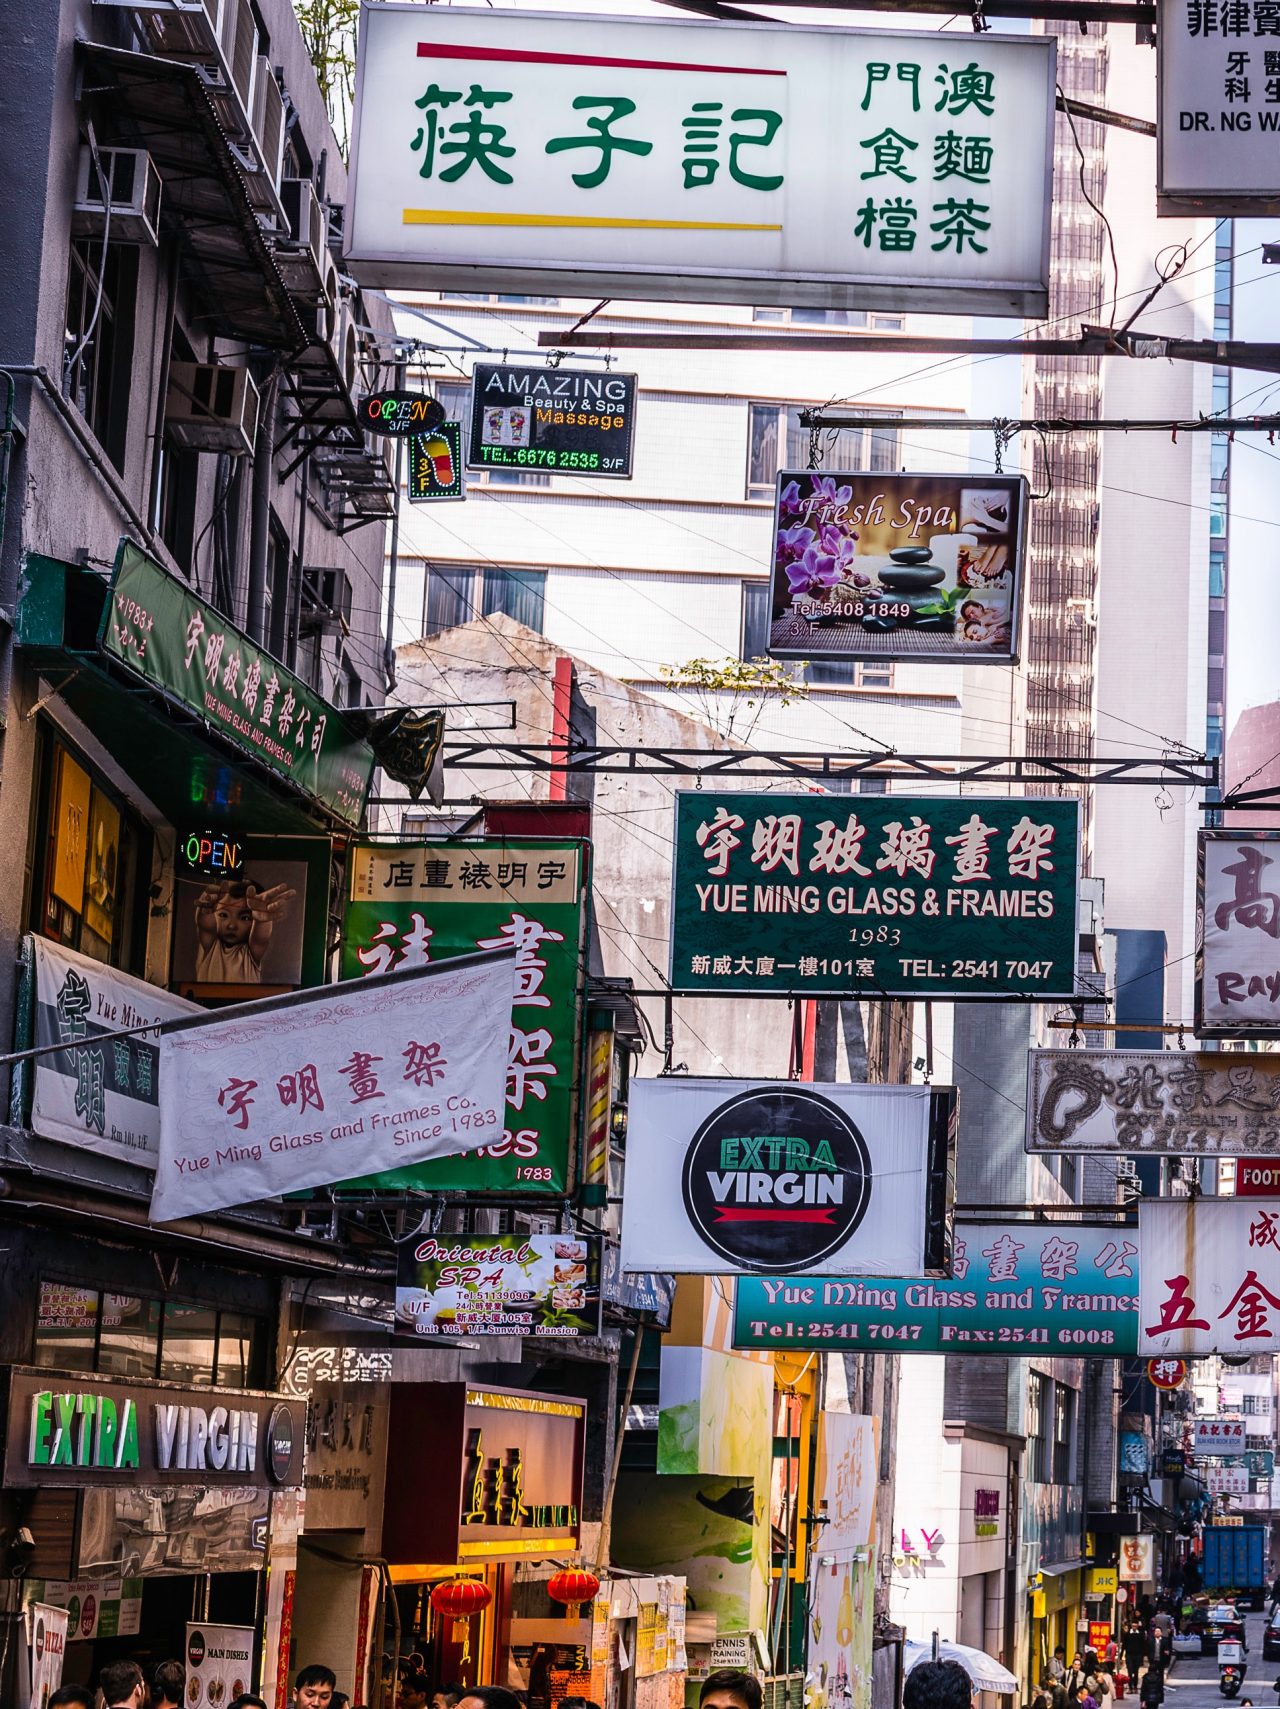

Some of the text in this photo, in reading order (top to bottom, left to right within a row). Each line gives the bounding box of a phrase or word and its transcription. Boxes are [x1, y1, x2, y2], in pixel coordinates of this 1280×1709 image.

[1179, 112, 1216, 132] DR.
[1220, 112, 1252, 132] NG
[410, 84, 784, 191] 筷子記
[485, 371, 627, 400] AMAZING
[368, 399, 432, 420] OPEN
[523, 395, 626, 414] Beauty Spa
[388, 420, 410, 432] 3/F
[536, 408, 625, 430] Massage
[559, 451, 625, 470] 2535 3/F
[794, 493, 953, 538] Fresh Spa
[869, 602, 911, 618] 1849
[186, 837, 237, 869] OPEN
[695, 806, 1055, 883] 宇明玻璃畫架
[696, 884, 1054, 918] YUE MING GLASS & FRAMES
[849, 926, 900, 947] 1983
[898, 958, 946, 977] TEL:
[951, 959, 999, 978] 2541
[1004, 960, 1054, 979] 7047
[217, 1040, 448, 1130] 宇明畫架
[173, 1094, 478, 1176] Yue Ming Glass and Frames Co.
[392, 1125, 443, 1148] Since
[450, 1109, 498, 1134] 1983
[719, 1136, 838, 1172] EXTRA
[516, 1166, 553, 1181] 1983
[1243, 1168, 1280, 1186] FOOT
[706, 1171, 844, 1204] VIRGIN
[415, 1238, 531, 1264] Oriental
[435, 1266, 506, 1288] SPA
[761, 1280, 1140, 1313] Yue Ming Glass and Frames
[416, 1325, 439, 1334] Unit
[488, 1326, 531, 1335] Sunwise
[536, 1327, 579, 1336] Mansion
[867, 1322, 1114, 1344] 7047 6008
[1155, 1360, 1179, 1383] 押
[29, 1388, 141, 1468] EXTRA
[154, 1402, 259, 1472] VIRGIN
[207, 1648, 250, 1661] MAIN DISHES
